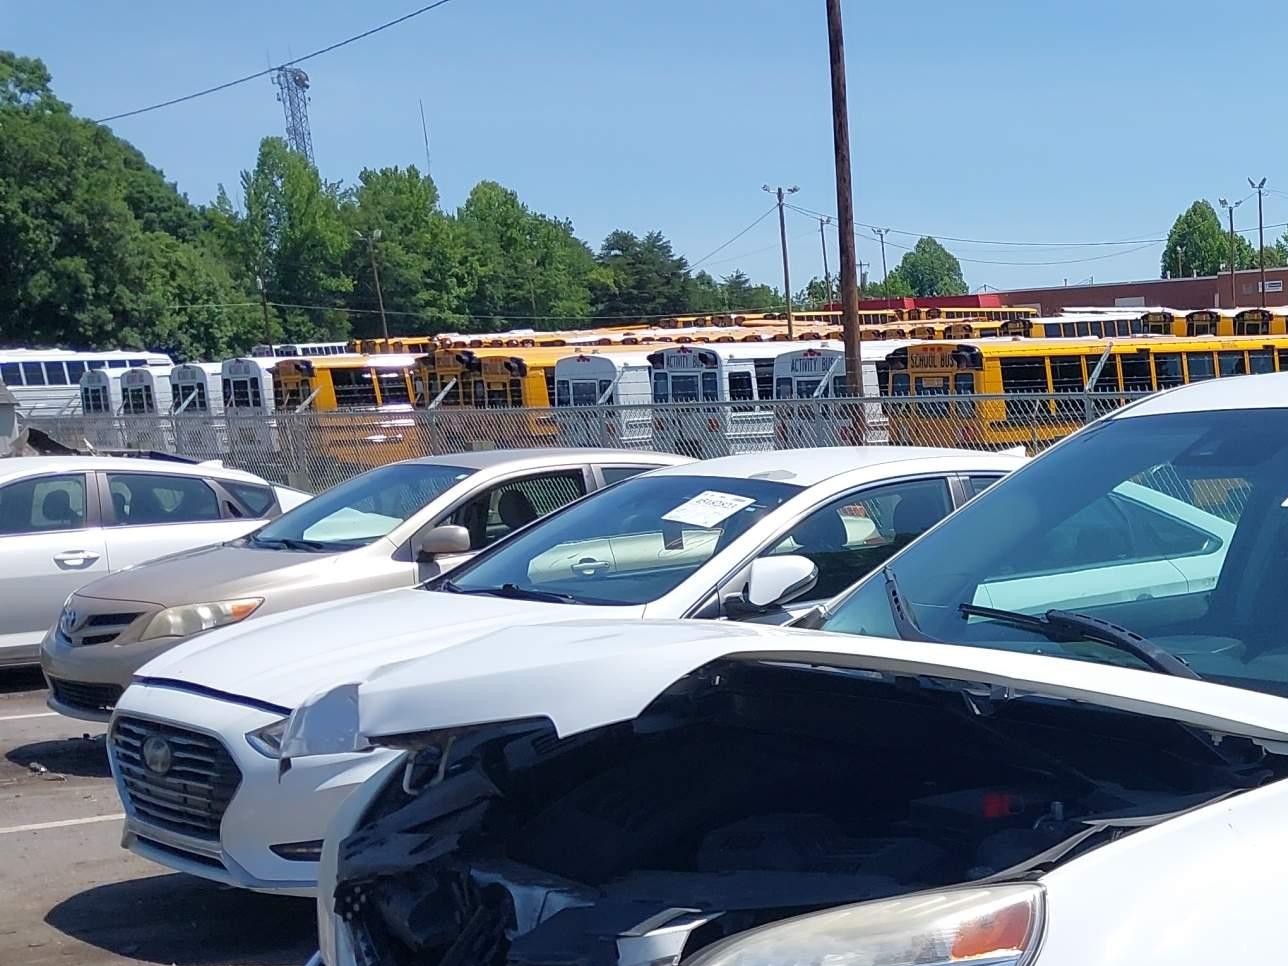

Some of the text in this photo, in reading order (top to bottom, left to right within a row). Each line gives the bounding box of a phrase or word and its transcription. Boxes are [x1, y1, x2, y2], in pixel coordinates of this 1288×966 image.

[666, 354, 688, 368] ACTIVITY
[790, 356, 817, 372] ACTIVITY
[910, 352, 937, 368] SCHOOL
